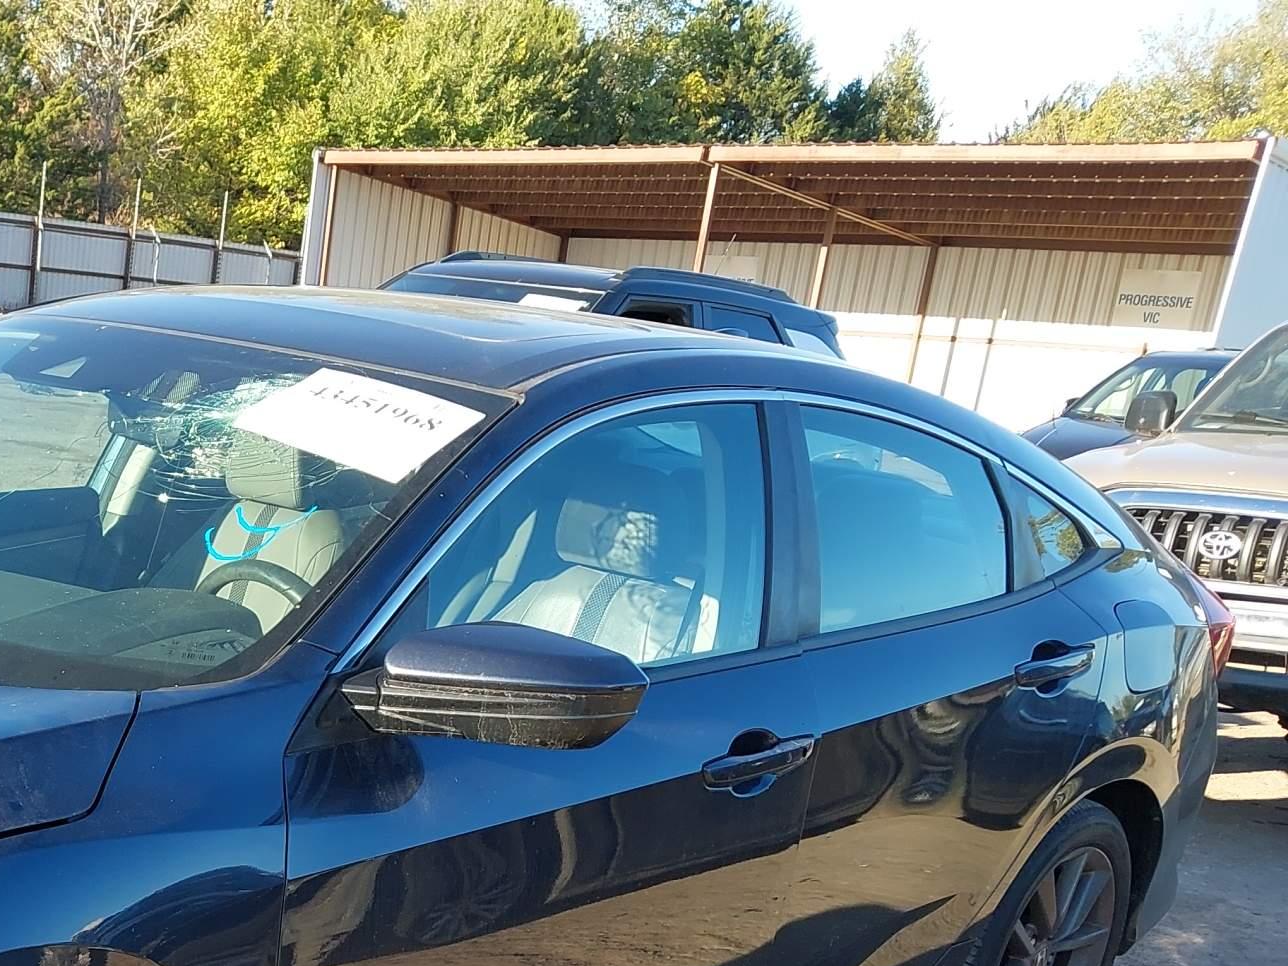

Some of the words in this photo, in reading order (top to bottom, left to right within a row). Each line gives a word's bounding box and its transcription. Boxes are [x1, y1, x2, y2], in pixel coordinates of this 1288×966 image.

[1118, 293, 1194, 309] PROGRESSIVE
[1143, 311, 1161, 324] VIC
[309, 386, 443, 431] 43451968
